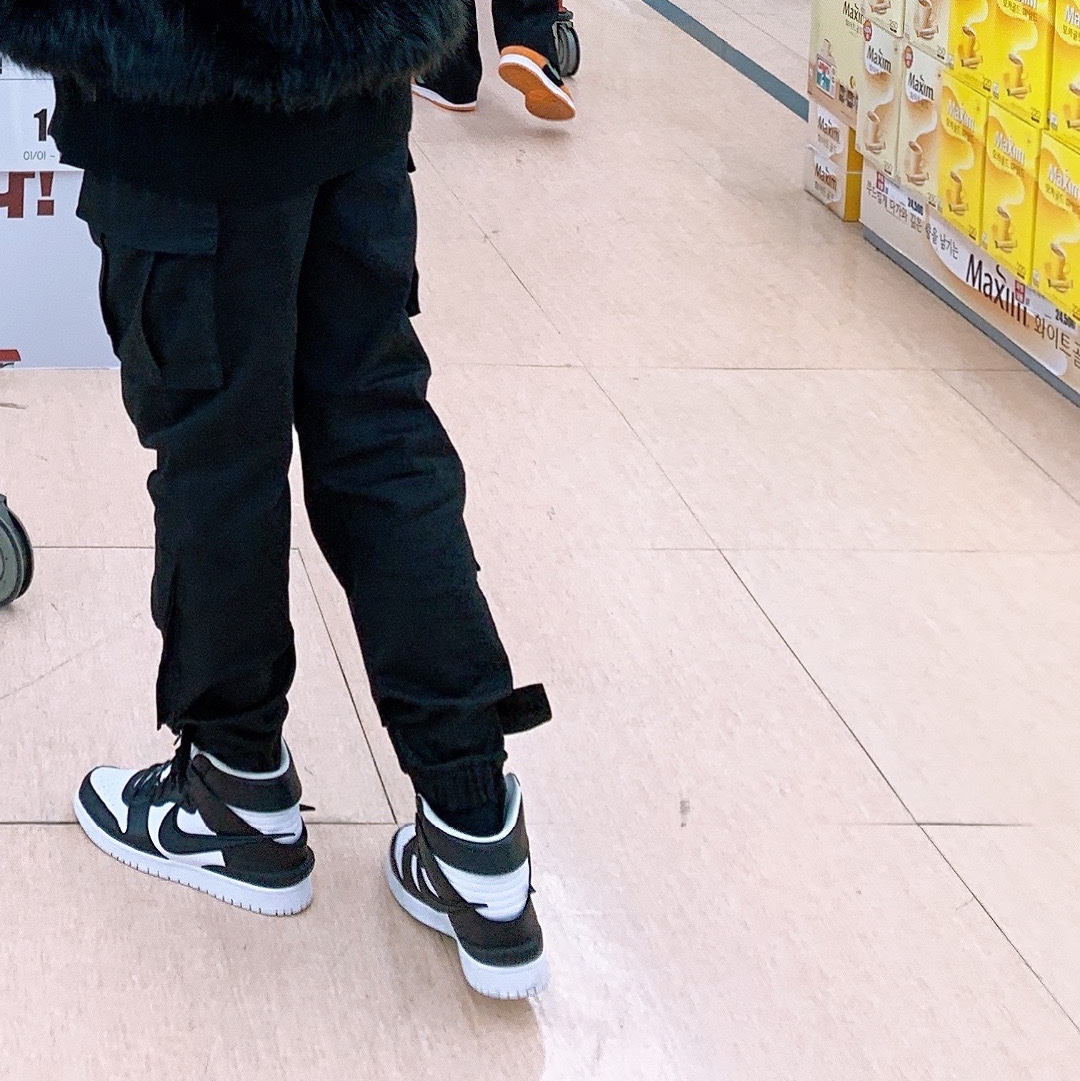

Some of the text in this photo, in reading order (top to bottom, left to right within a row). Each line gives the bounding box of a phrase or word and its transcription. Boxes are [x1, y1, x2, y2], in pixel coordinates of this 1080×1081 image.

[867, 45, 892, 74] Maxim
[908, 71, 934, 101] Maxim
[818, 115, 840, 144] Maxim
[948, 98, 975, 132] Maxim
[23, 151, 47, 161] 01/01
[995, 131, 1025, 164] Maxim
[814, 162, 837, 191] Maxim
[940, 233, 960, 260] 남기는
[966, 253, 1029, 328] Maxim
